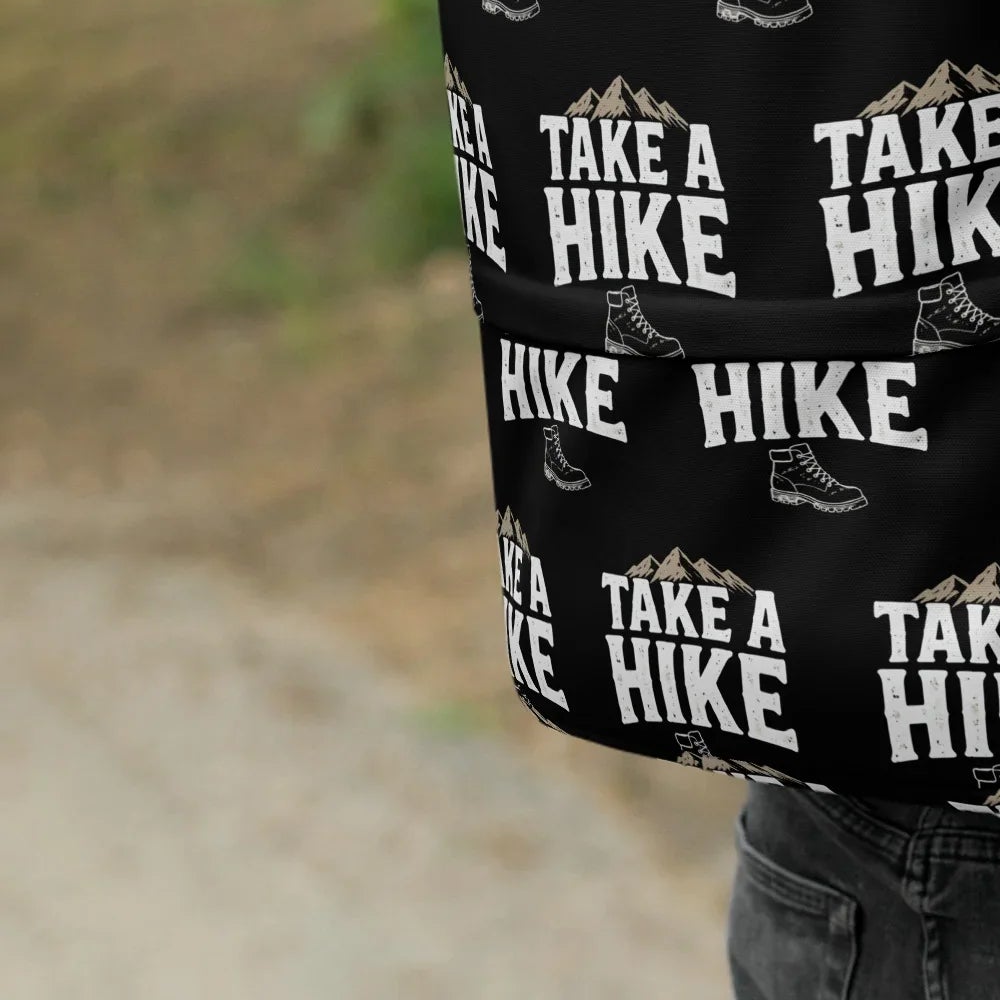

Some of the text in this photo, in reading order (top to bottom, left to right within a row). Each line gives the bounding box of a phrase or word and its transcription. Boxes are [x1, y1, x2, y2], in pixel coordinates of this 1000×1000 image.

[447, 89, 493, 170] KE A
[539, 114, 725, 191] TAKE A
[454, 153, 507, 274] KE
[543, 187, 736, 298] HIKE
[500, 339, 628, 443] HIKE
[691, 360, 928, 452] HIKE
[503, 536, 552, 617] KE A
[601, 572, 786, 653] TAKE A
[504, 596, 570, 712] KE
[605, 634, 799, 752] HIKE
